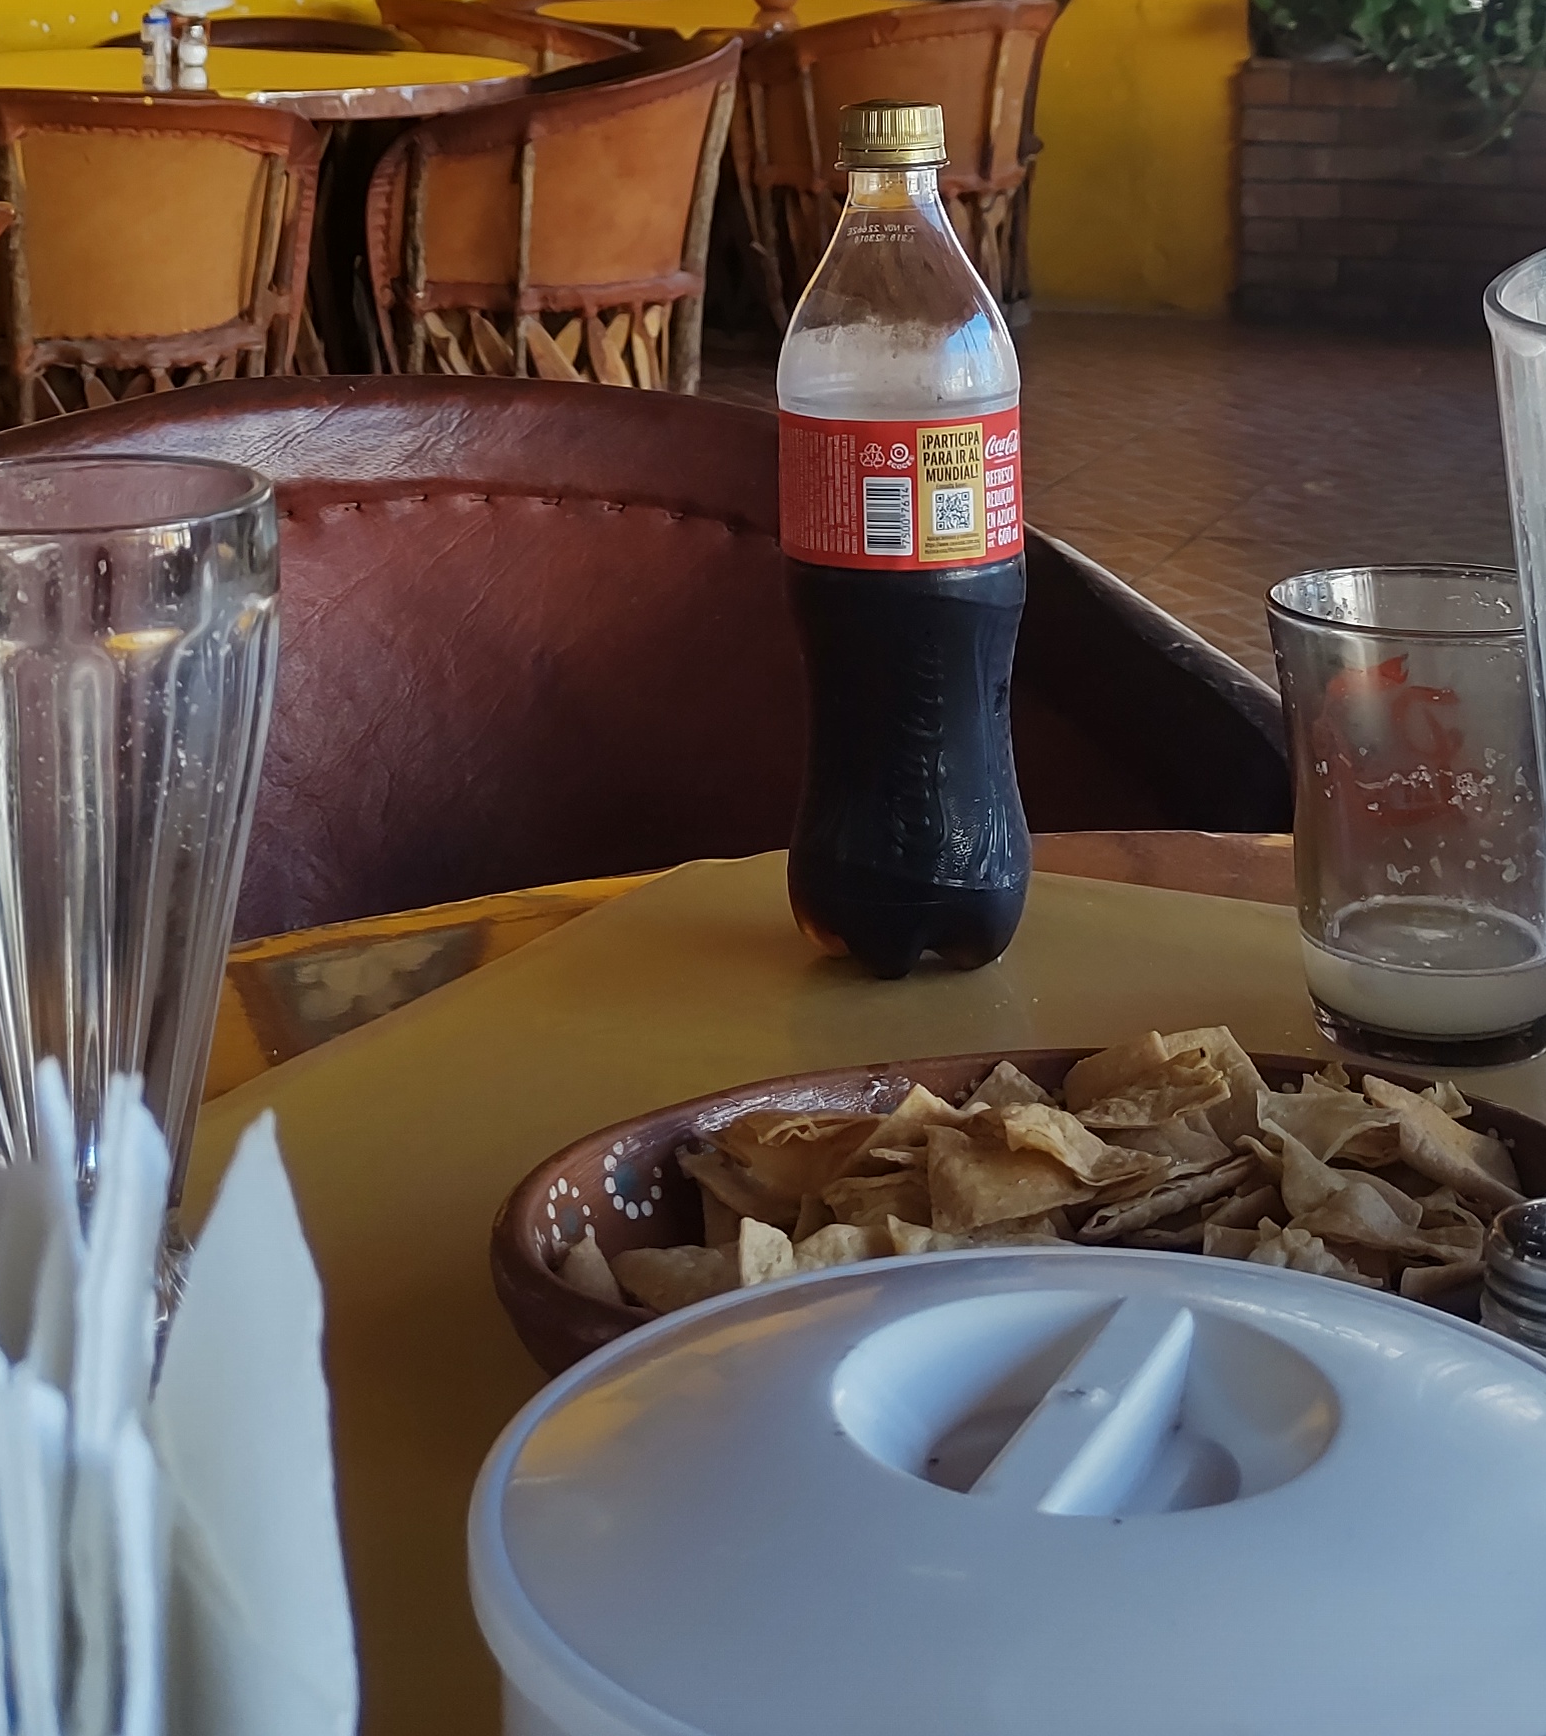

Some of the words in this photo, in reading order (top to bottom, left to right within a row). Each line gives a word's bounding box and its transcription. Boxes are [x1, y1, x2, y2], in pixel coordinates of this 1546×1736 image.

[922, 430, 980, 450] ¡PARTICIPA
[923, 450, 953, 467] PARA
[956, 449, 967, 464] IR
[968, 447, 980, 462] AL
[926, 464, 979, 483] MUNDIAL!
